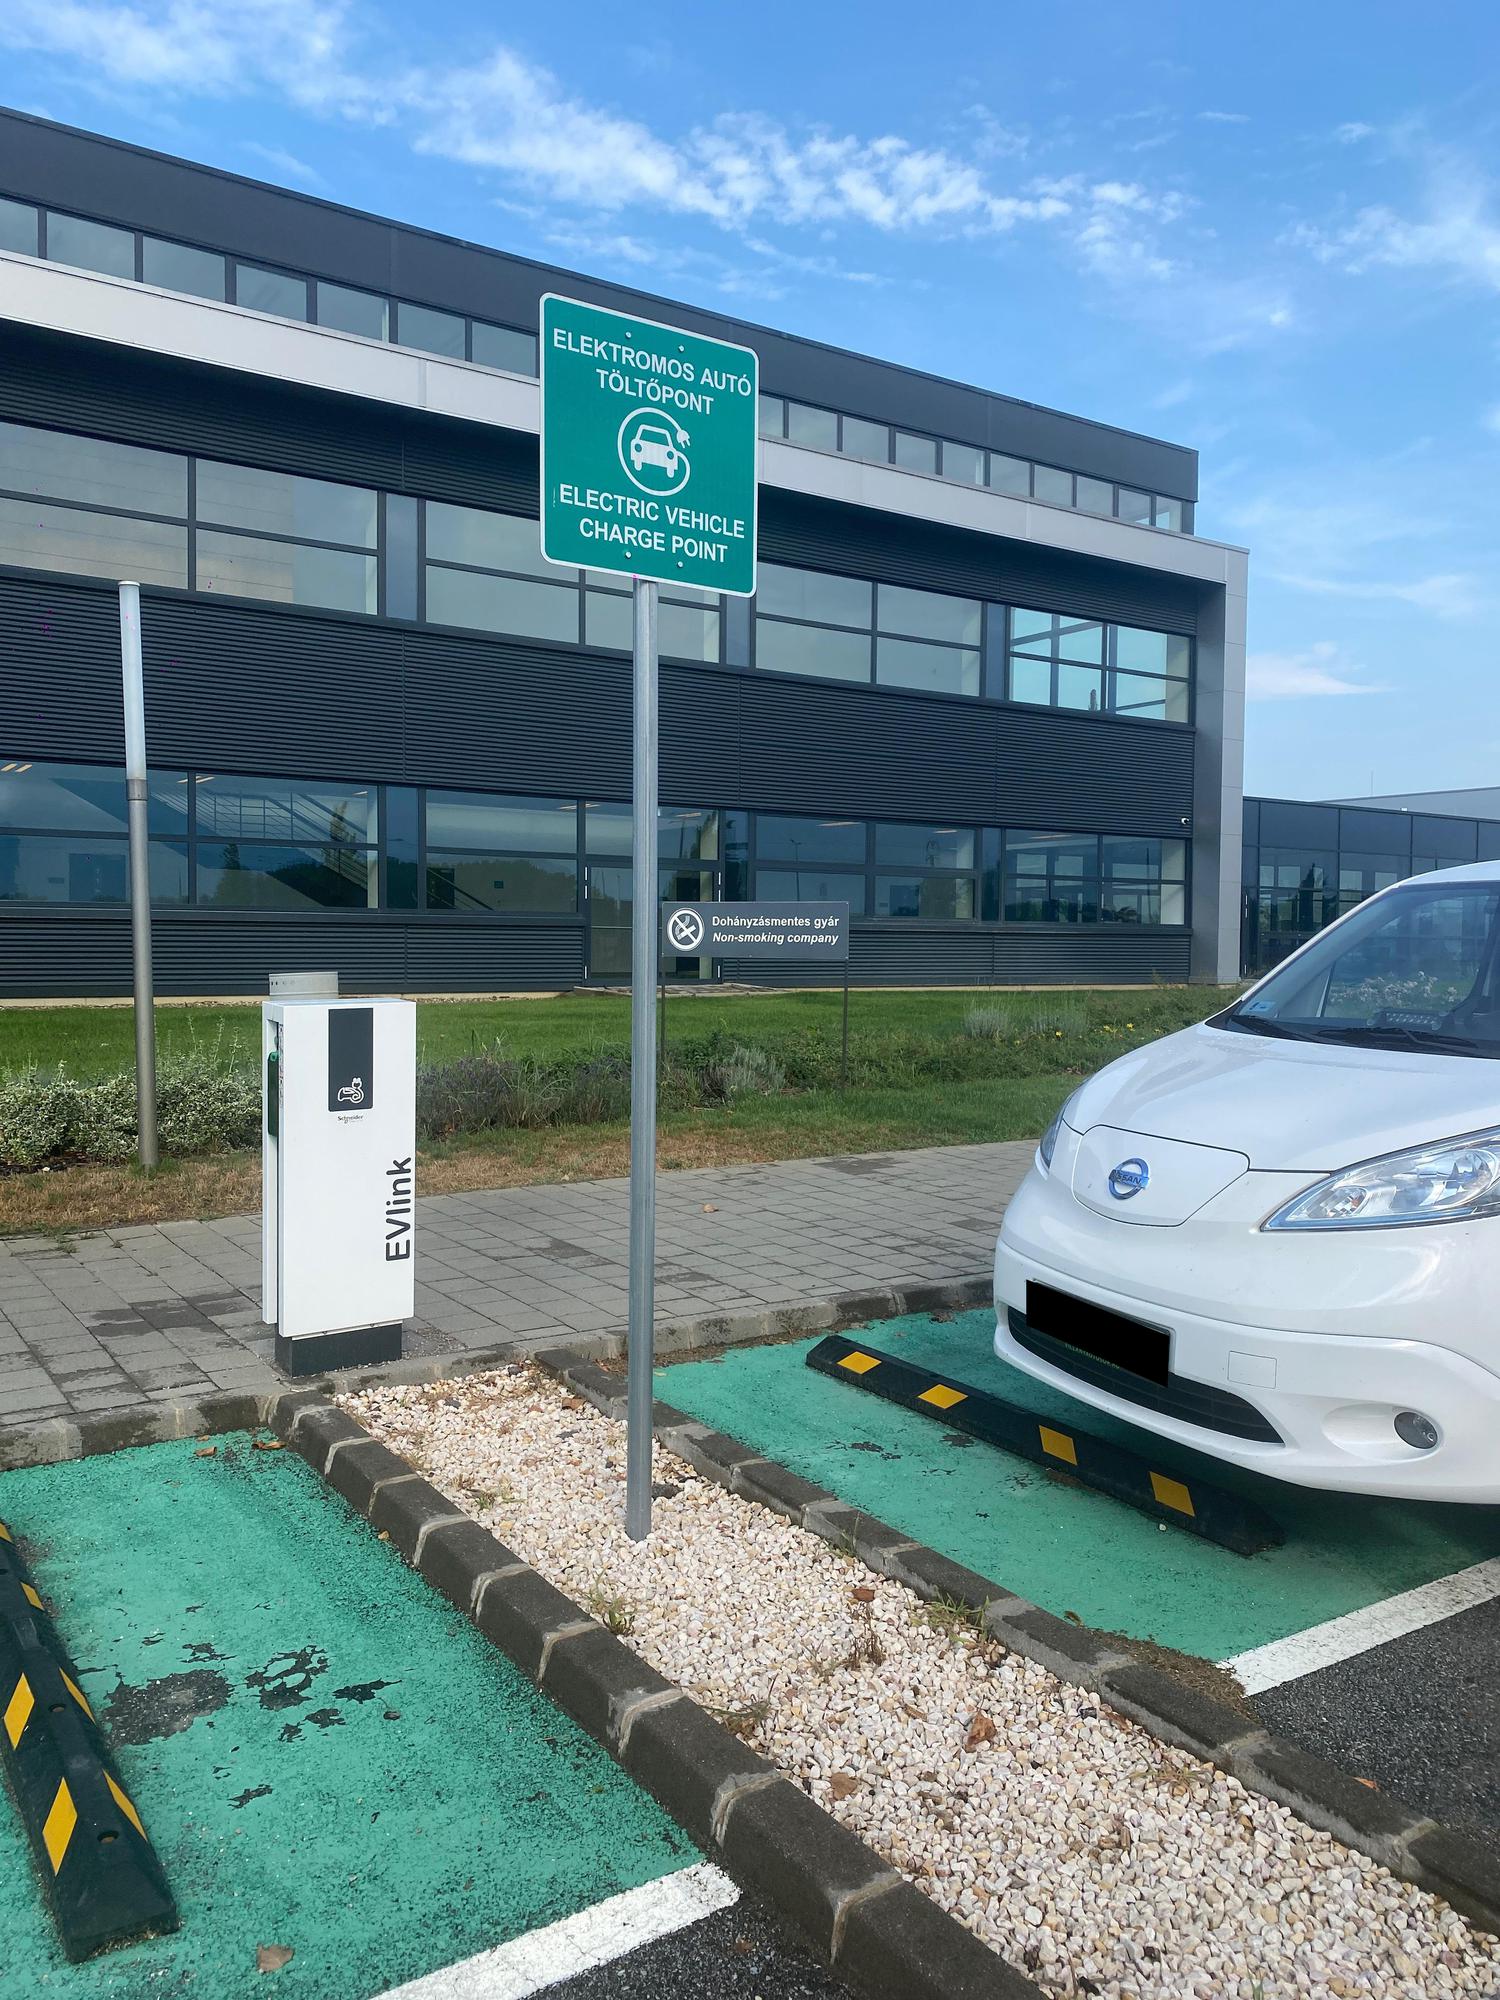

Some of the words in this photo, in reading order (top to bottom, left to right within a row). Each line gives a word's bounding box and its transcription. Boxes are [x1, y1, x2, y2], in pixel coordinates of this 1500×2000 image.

[553, 327, 695, 381] ELEKTROMOS
[700, 367, 751, 396] AUTÓ
[596, 369, 714, 415] TÖLTŐPONT
[560, 483, 659, 522] ELECTRIC
[665, 505, 744, 538] VEHICLE
[580, 517, 665, 551] CHARGE
[672, 535, 728, 563] POINT
[712, 916, 811, 928] Dohányzásmentes
[814, 916, 839, 929] gyár
[713, 932, 784, 945] Non-smoking
[787, 934, 839, 945] company
[386, 1157, 411, 1261] EVlink
